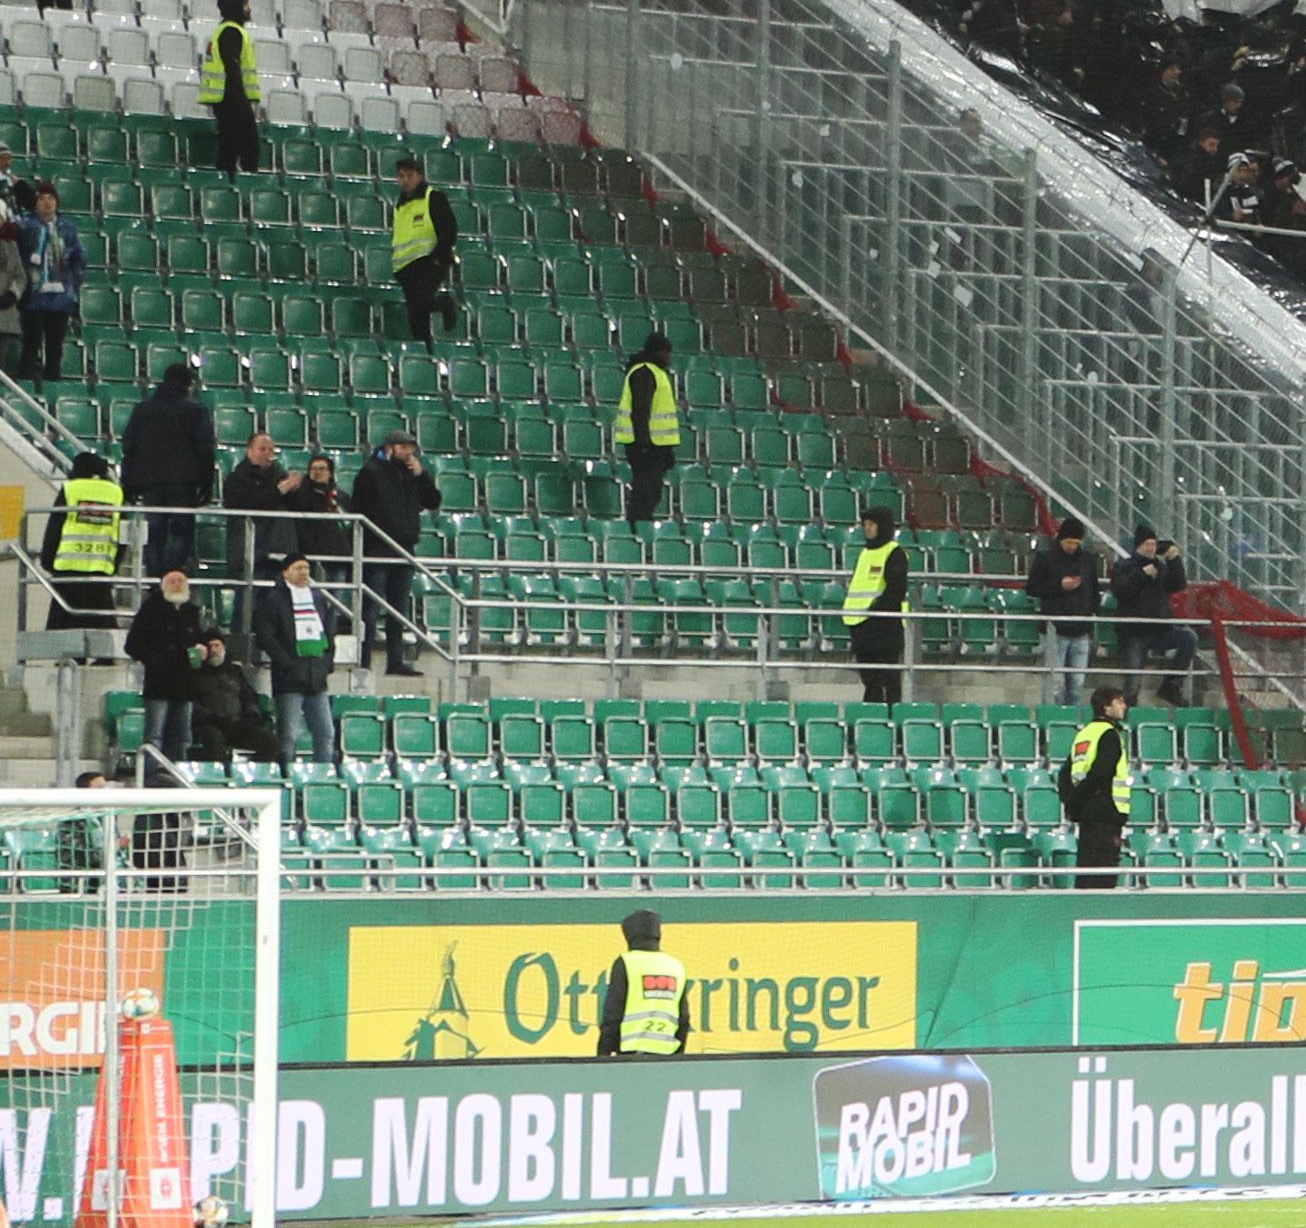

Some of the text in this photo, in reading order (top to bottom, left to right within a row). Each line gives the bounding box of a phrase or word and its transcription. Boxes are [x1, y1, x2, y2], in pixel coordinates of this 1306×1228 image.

[0, 1001, 108, 1057] RGI
[504, 951, 881, 1053] Ottringer
[154, 1053, 168, 1118] ENERGIE
[839, 1082, 969, 1147] RAPID
[835, 1122, 972, 1194] MOBIL
